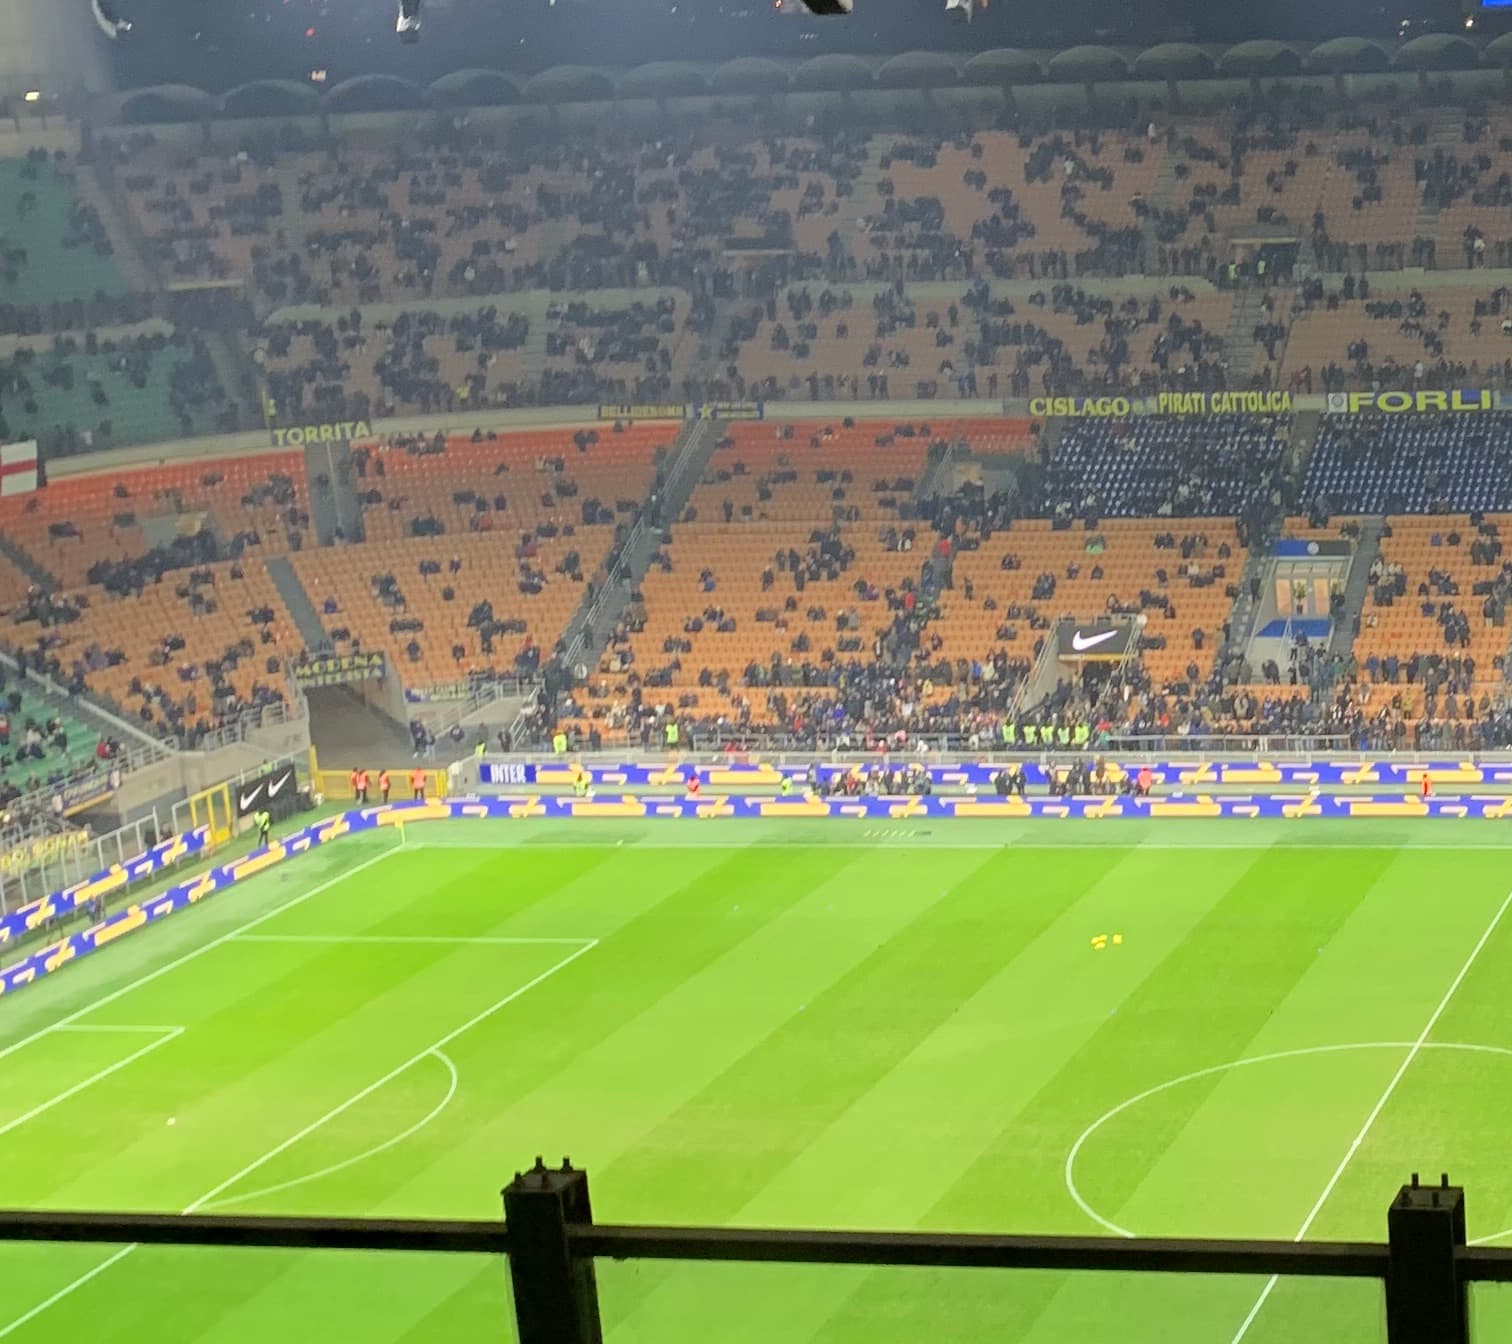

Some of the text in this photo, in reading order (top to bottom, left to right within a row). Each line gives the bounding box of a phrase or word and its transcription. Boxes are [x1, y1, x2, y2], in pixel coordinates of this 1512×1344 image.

[1029, 396, 1131, 417] CISLAGO
[1158, 390, 1291, 413] PIRATI CATTOLICA
[1349, 389, 1492, 413] FORLI
[273, 420, 370, 447] TORRITA
[295, 654, 383, 677] MODENA
[490, 763, 527, 784] INTER
